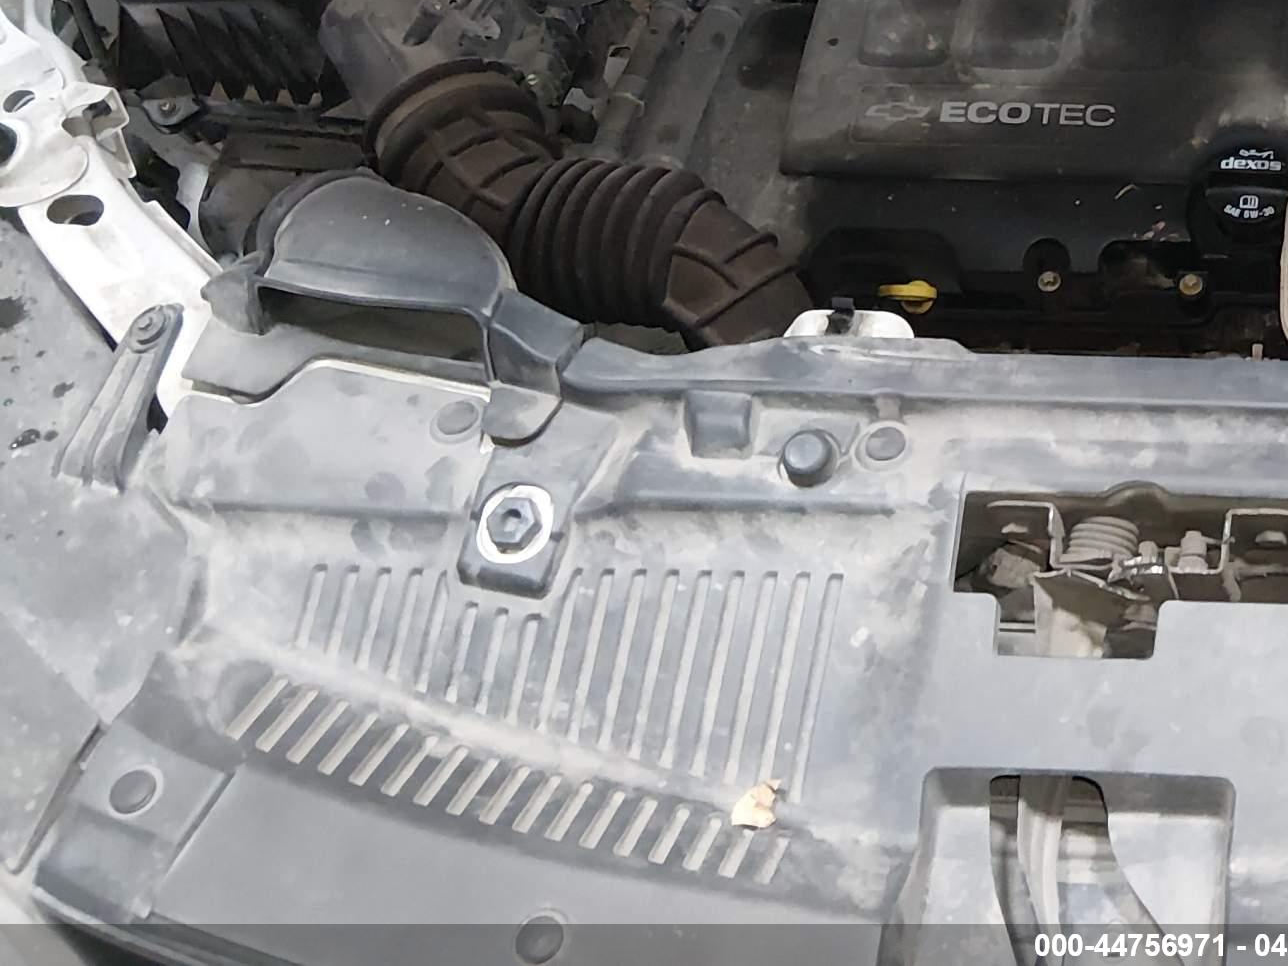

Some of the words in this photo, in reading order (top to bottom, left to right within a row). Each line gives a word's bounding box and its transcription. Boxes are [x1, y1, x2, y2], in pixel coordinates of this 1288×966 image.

[939, 101, 1116, 127] ECOTEC
[1220, 157, 1281, 170] dexos
[1224, 206, 1241, 218] SAE
